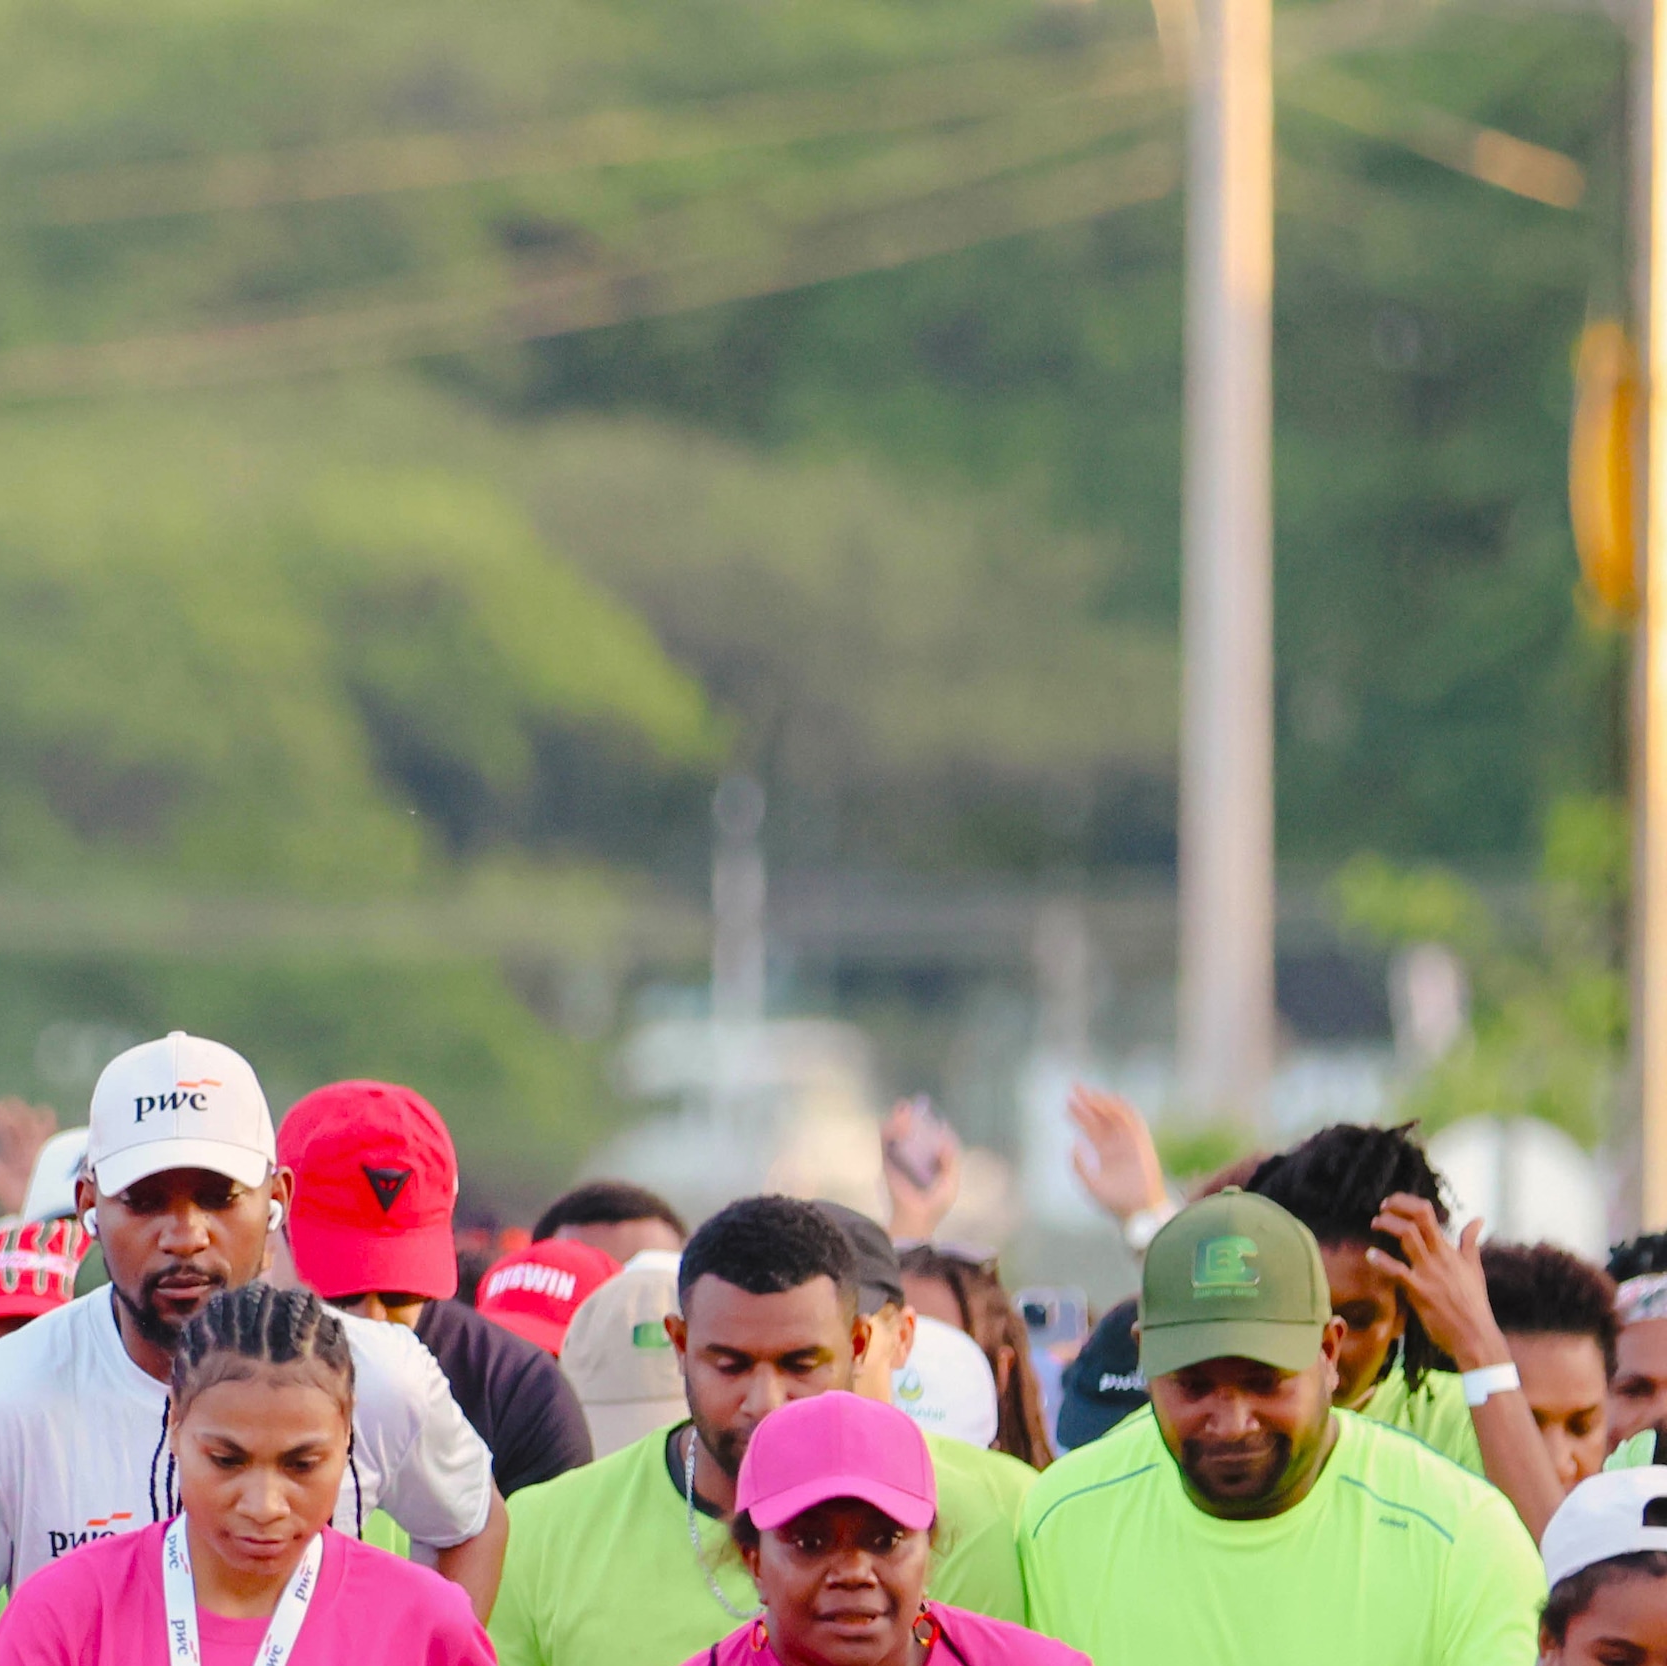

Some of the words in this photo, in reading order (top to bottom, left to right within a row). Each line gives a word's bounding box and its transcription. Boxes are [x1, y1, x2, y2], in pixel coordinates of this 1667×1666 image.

[133, 1091, 208, 1124] pwc
[166, 1533, 180, 1570] pwc
[294, 1564, 315, 1603] pwc
[170, 1618, 189, 1656] pwc
